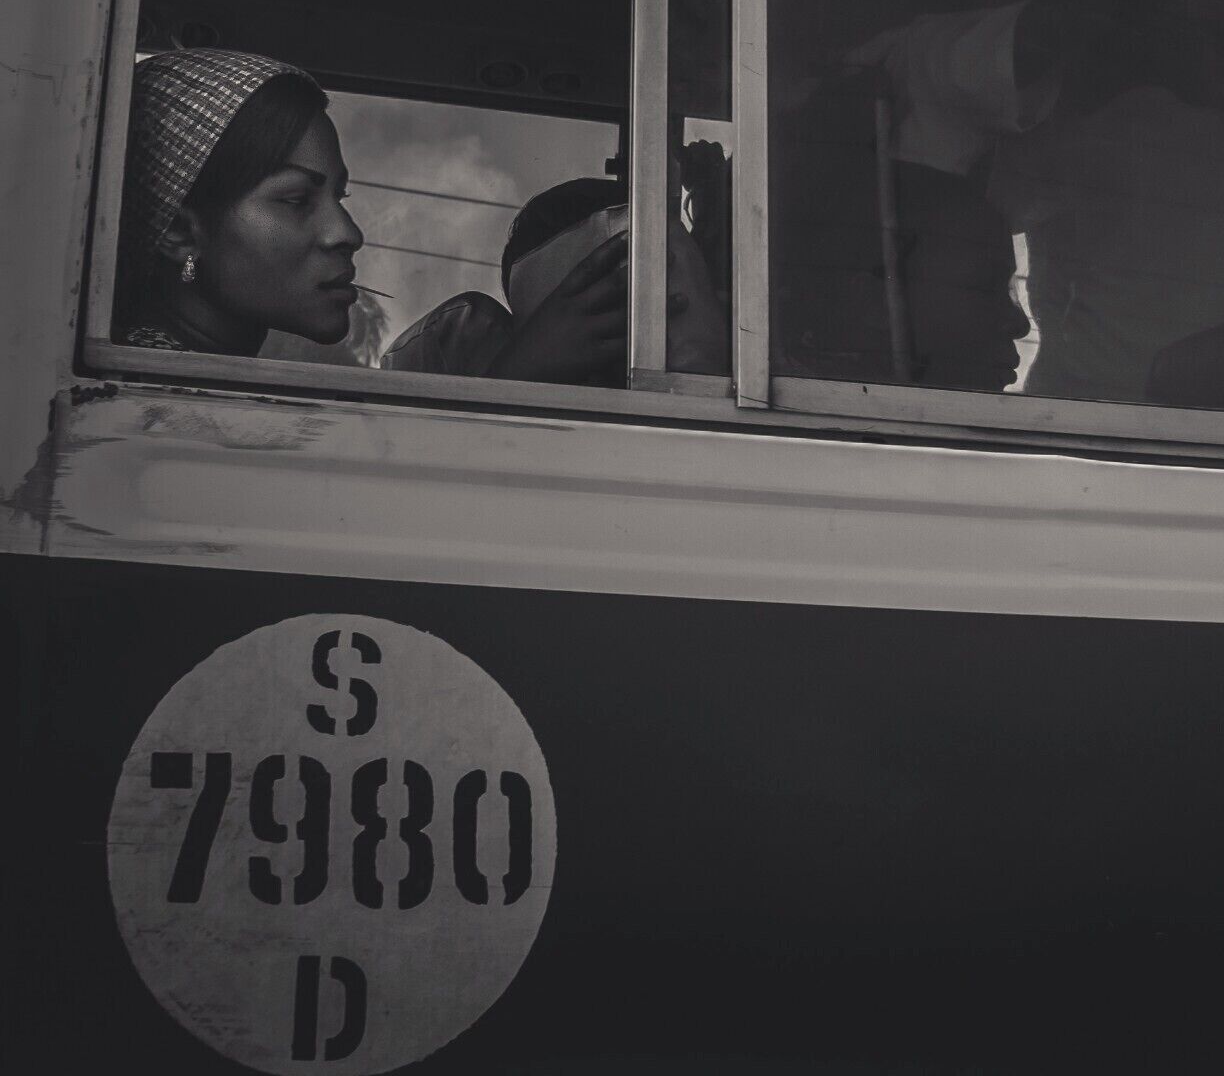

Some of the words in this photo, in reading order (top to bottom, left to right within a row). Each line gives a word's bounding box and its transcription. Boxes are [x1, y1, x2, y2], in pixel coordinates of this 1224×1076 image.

[306, 630, 381, 736] S
[150, 752, 532, 909] 7980
[292, 955, 367, 1061] D
